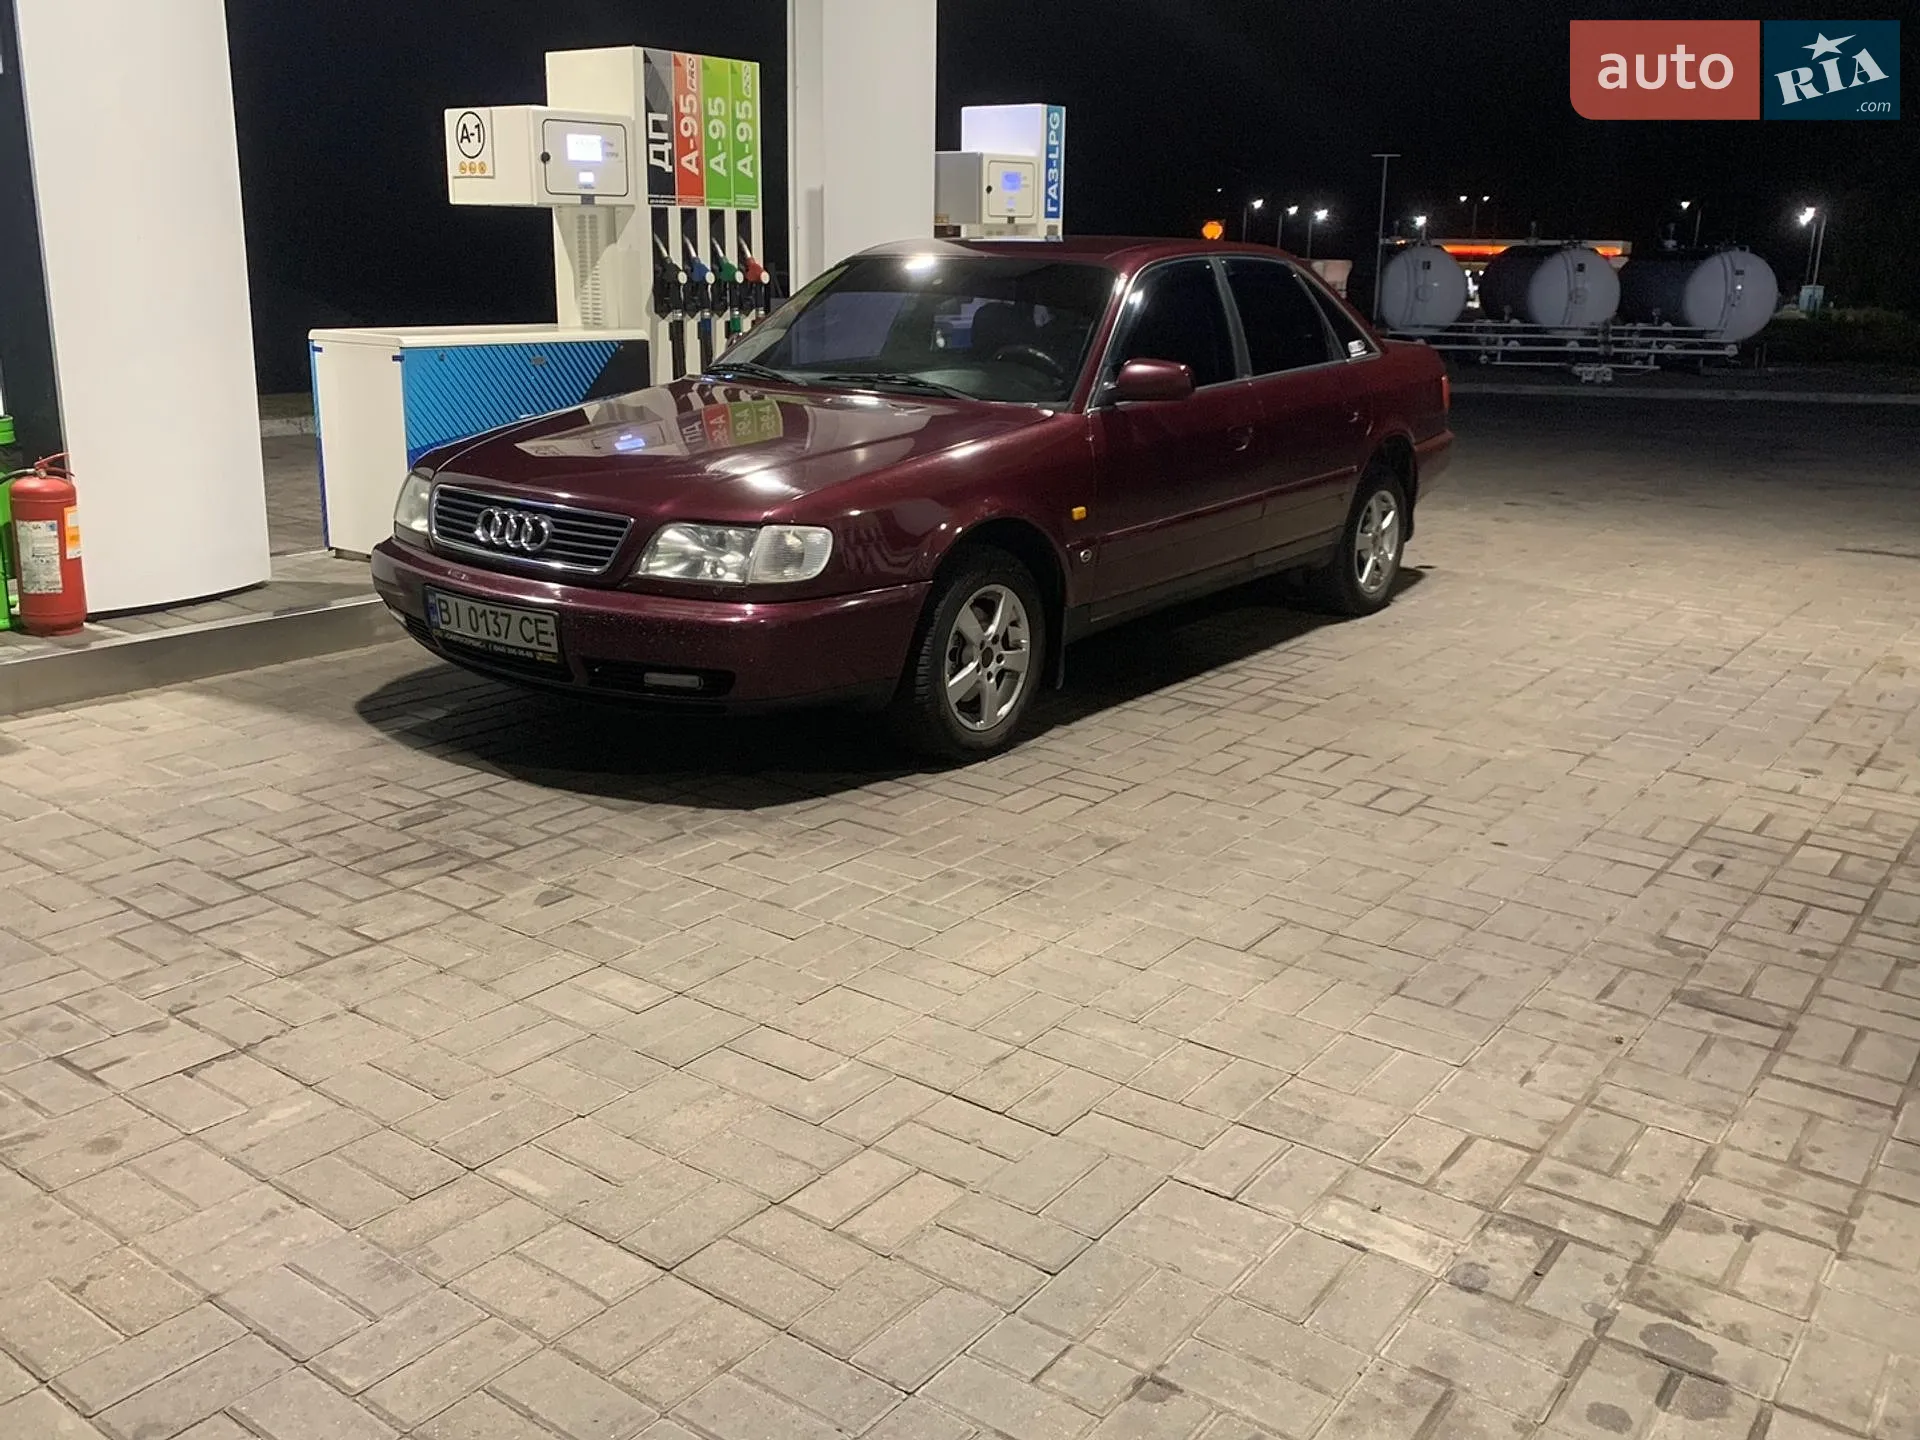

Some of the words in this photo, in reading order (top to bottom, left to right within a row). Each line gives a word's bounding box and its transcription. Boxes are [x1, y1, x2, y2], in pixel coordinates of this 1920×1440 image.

[648, 112, 673, 172] ДП
[437, 598, 461, 628] BI
[468, 606, 512, 640] 0137
[519, 616, 552, 647] CE
